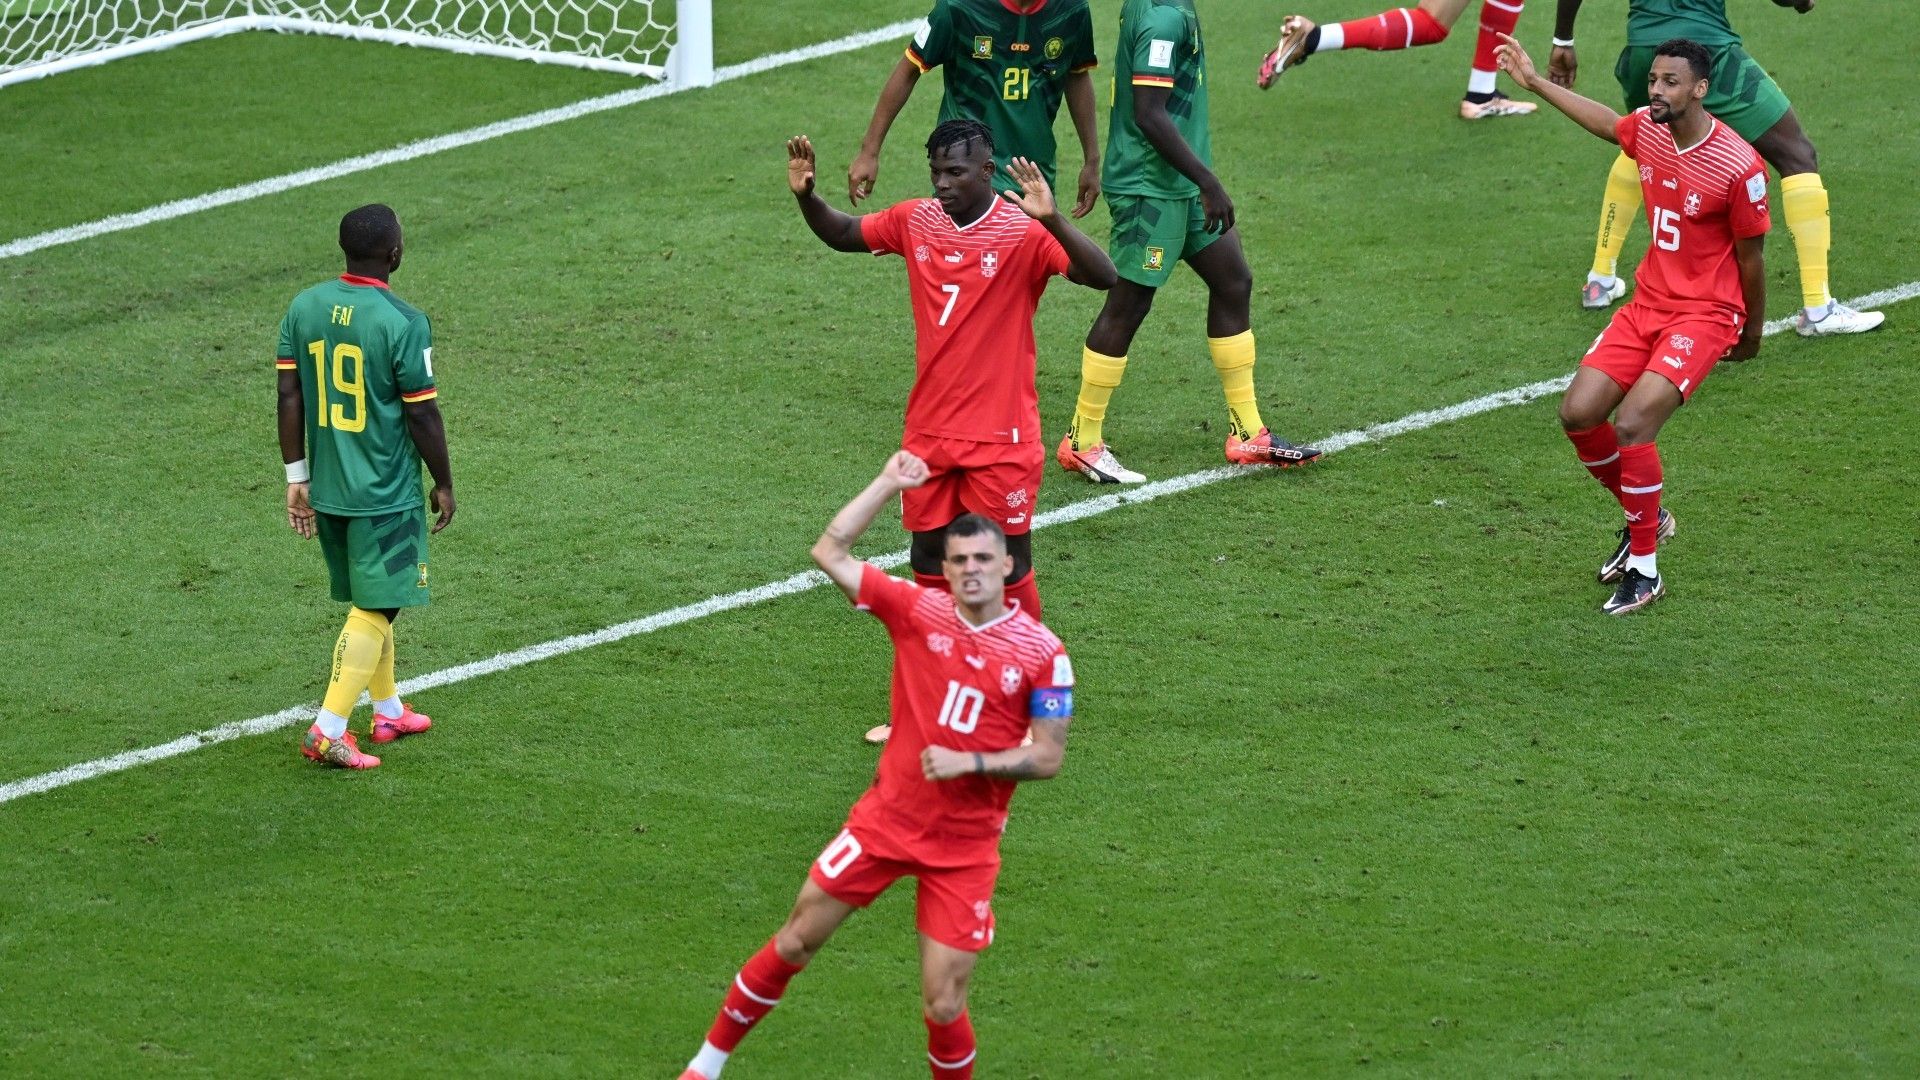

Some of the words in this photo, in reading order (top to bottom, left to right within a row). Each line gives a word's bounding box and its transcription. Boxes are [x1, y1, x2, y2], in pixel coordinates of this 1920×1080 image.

[1003, 67, 1030, 100] 21
[1601, 202, 1617, 249] CAMEROUN
[1653, 205, 1681, 252] 15
[938, 284, 960, 327] 7
[308, 339, 367, 433] 19
[332, 632, 350, 683] CAMEROUN
[937, 679, 985, 735] 10
[816, 827, 863, 879] 10
